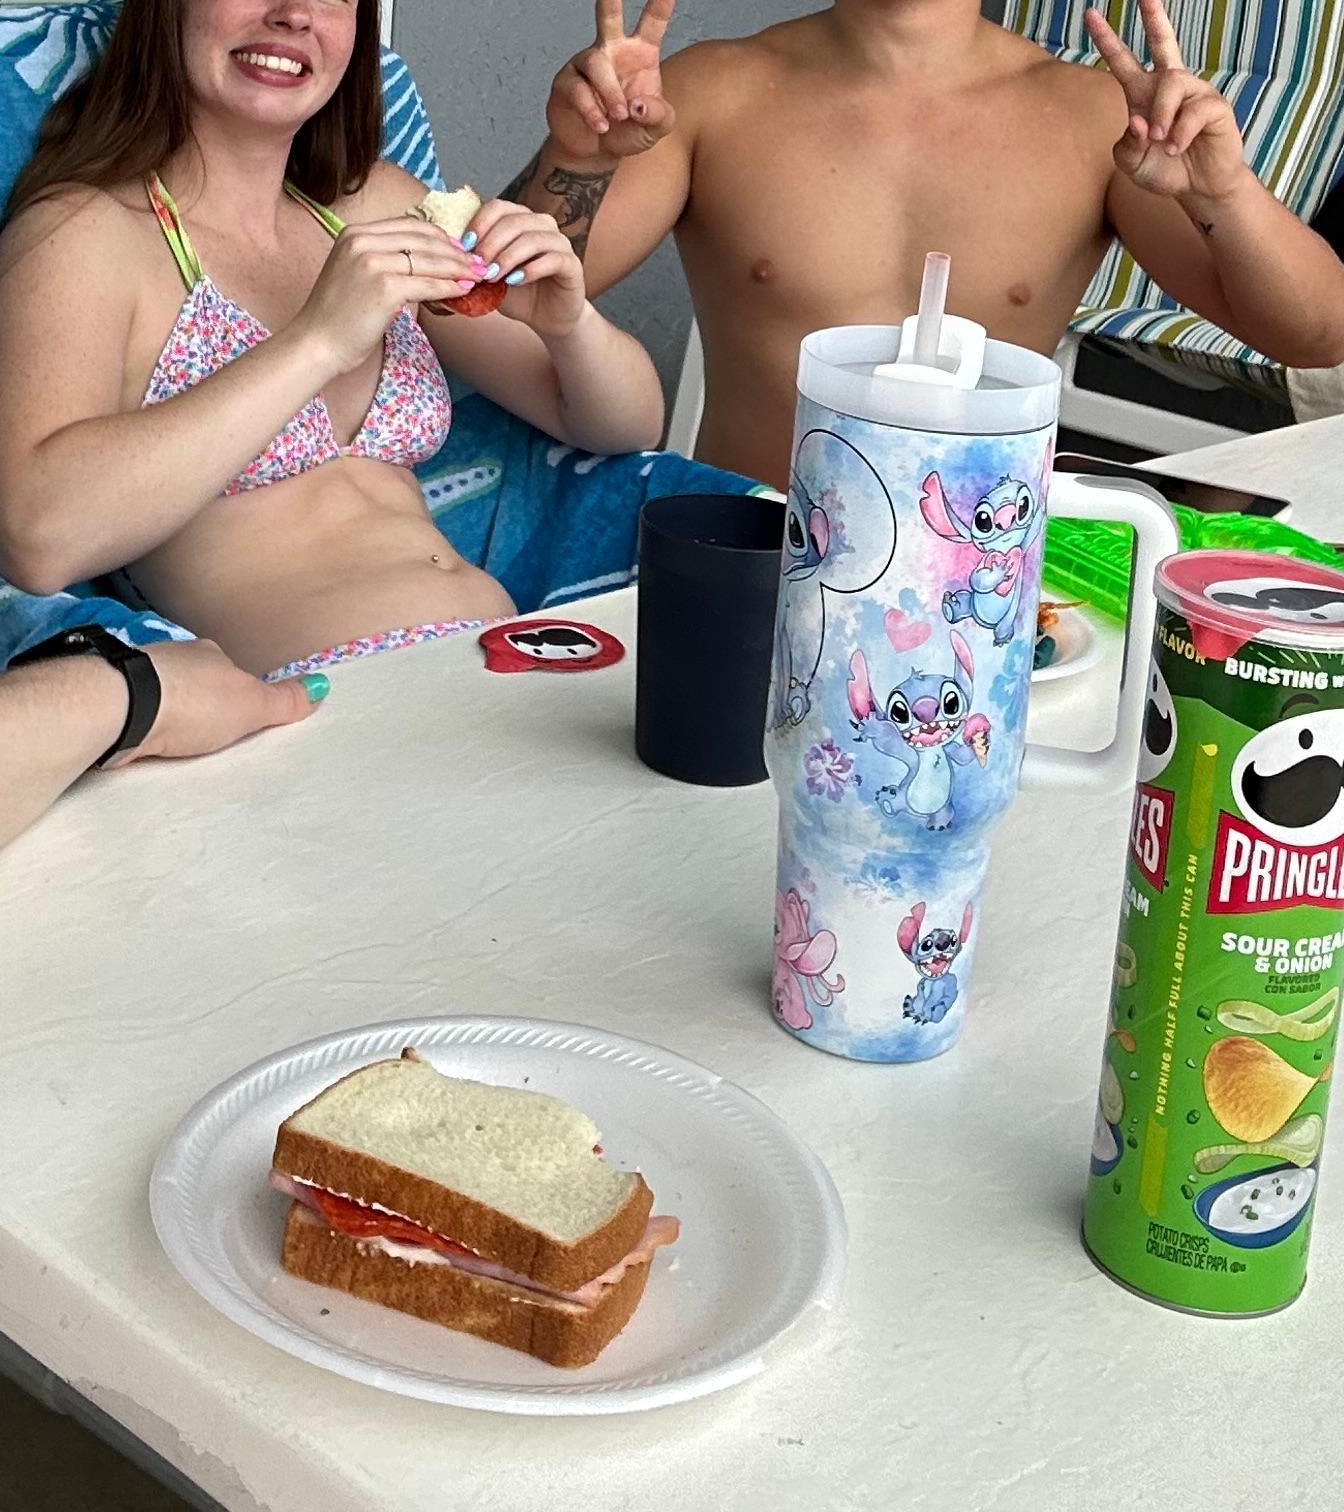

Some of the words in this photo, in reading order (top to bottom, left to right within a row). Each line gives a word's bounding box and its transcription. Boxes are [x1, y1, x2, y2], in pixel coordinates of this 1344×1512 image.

[1224, 656, 1329, 690] BURSTING
[1186, 854, 1198, 883] CAN
[1180, 887, 1193, 919] THIS
[1173, 922, 1189, 972] ABOUT
[1221, 931, 1290, 957] SOUR
[1254, 957, 1271, 974] &
[1275, 952, 1334, 974] ONION
[1169, 975, 1182, 1010] FULL
[1164, 1011, 1177, 1049] HALF
[1156, 1050, 1172, 1116] NOTHING
[1148, 1222, 1179, 1248] POTATO
[1179, 1229, 1210, 1254] CRISPS
[1145, 1238, 1193, 1268] CRUJIENTES
[1193, 1252, 1206, 1270] DE
[1206, 1255, 1228, 1273] PAPA
